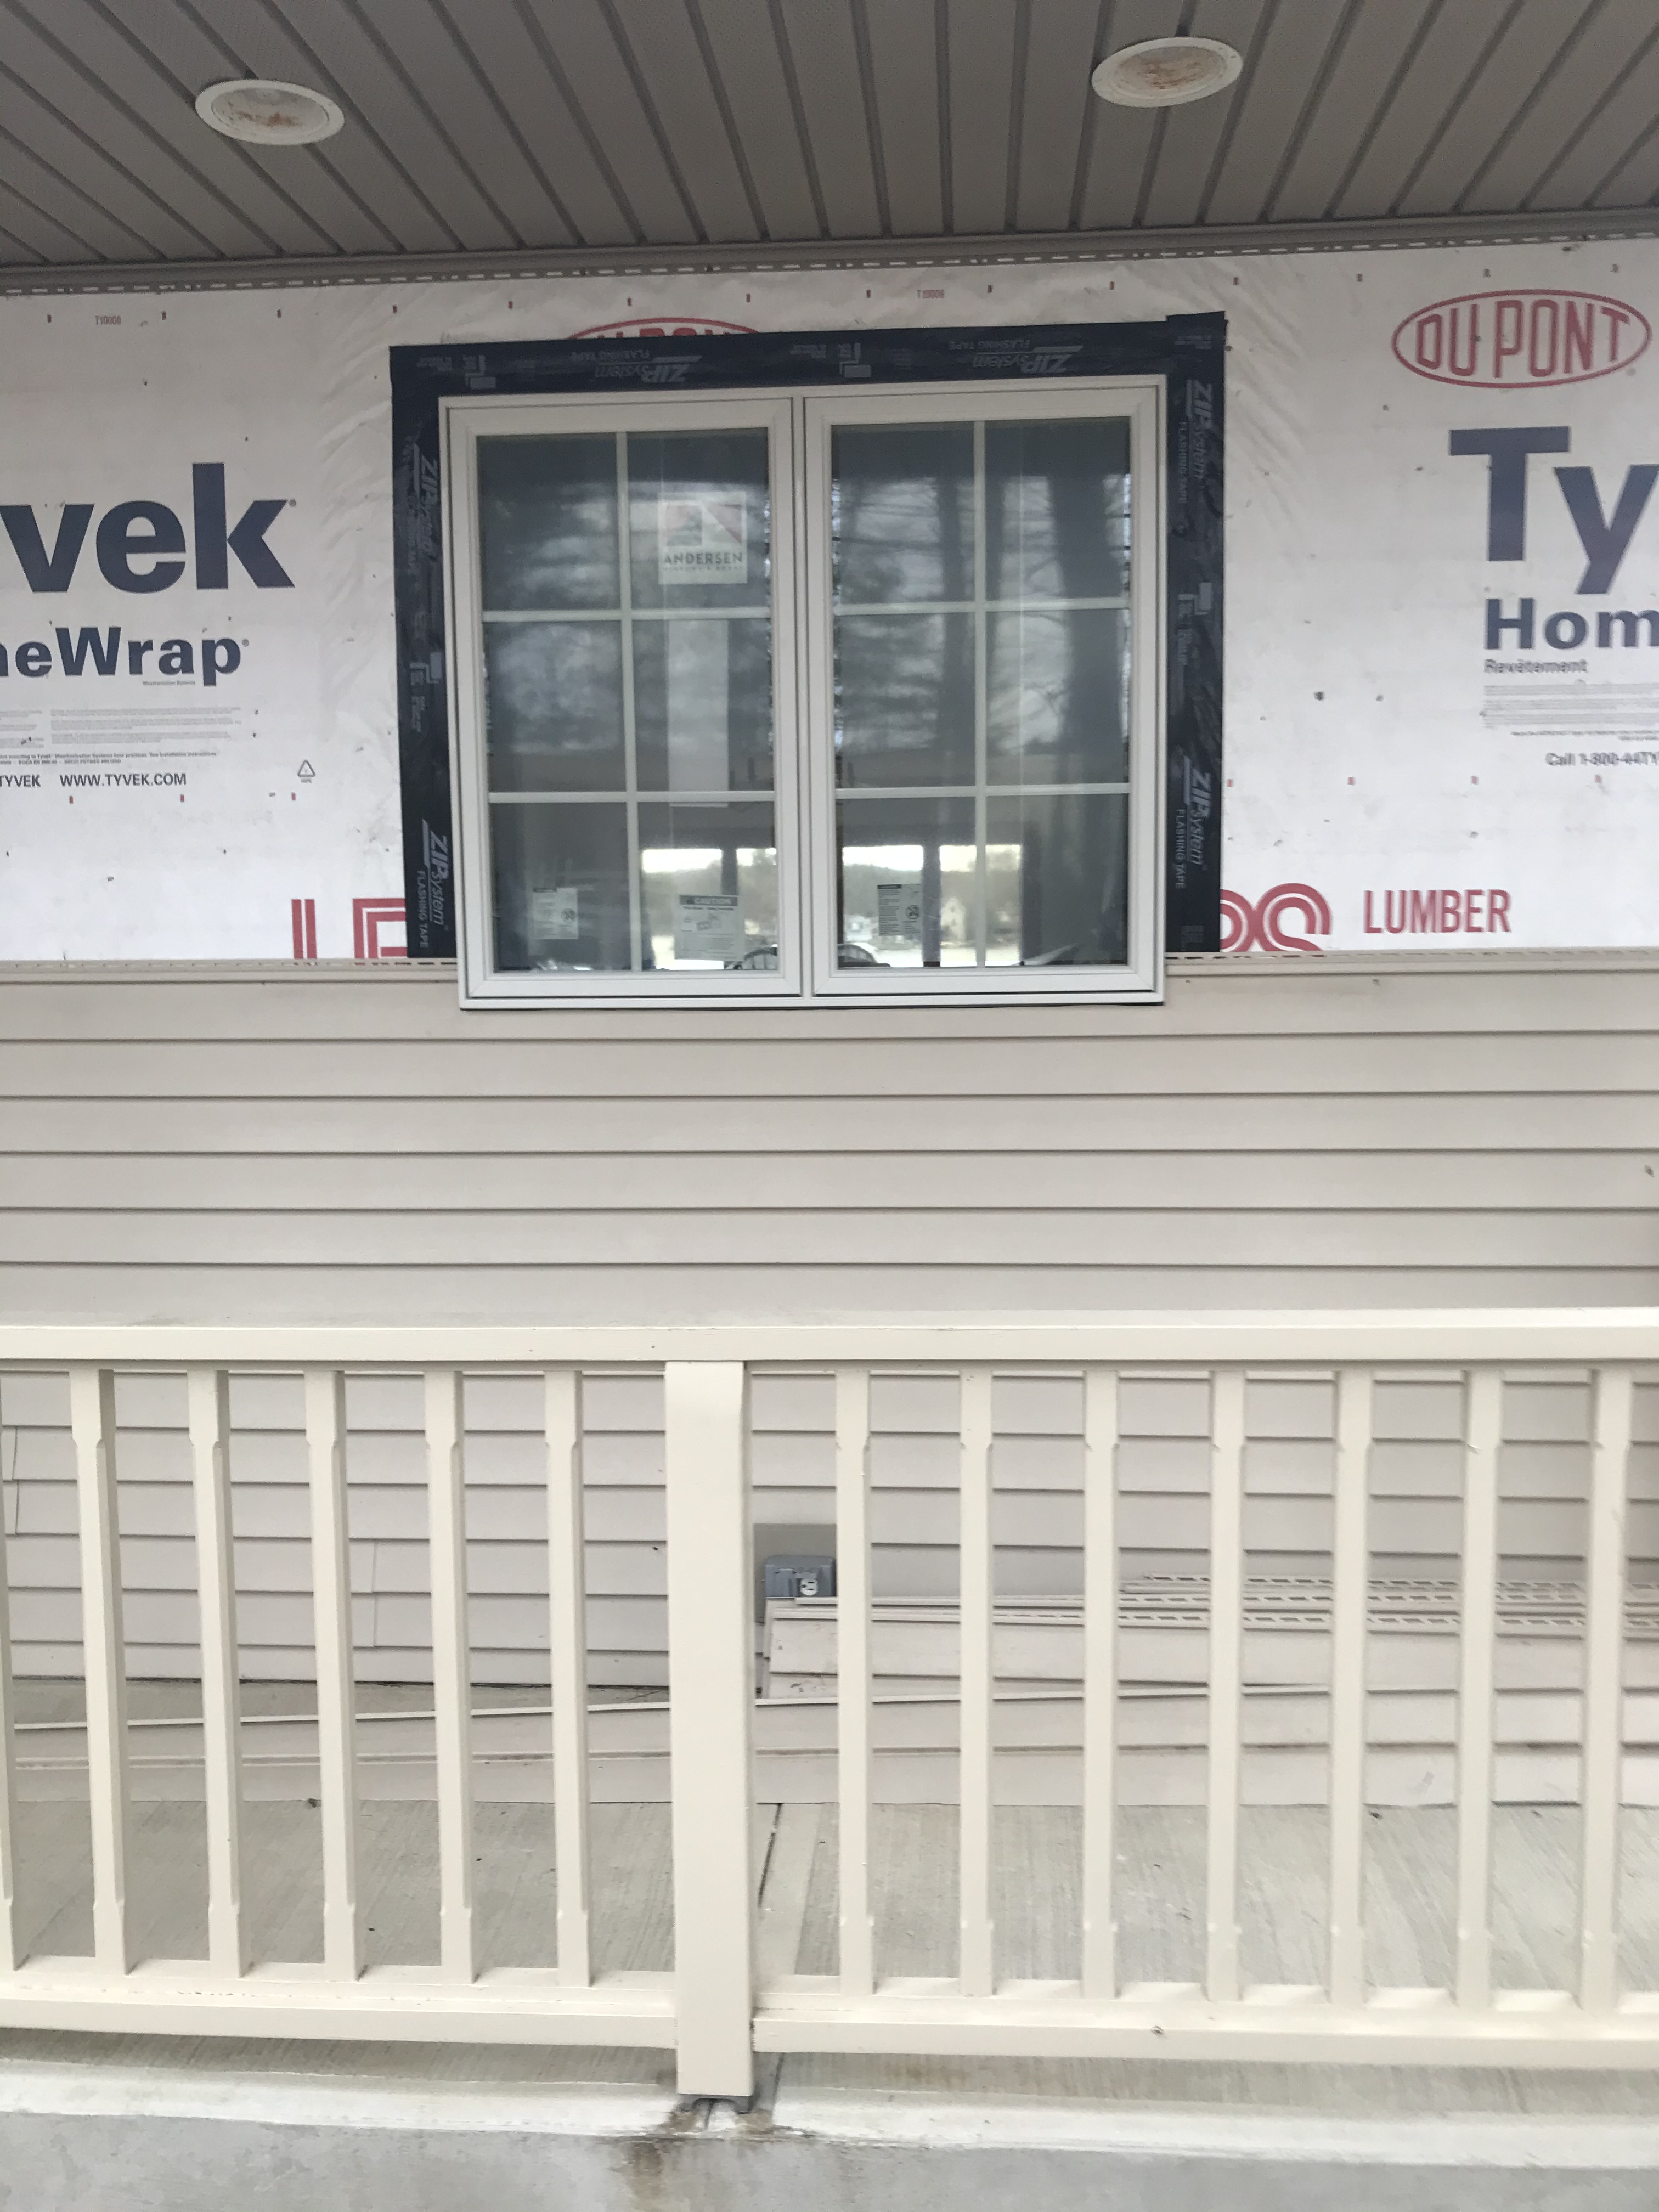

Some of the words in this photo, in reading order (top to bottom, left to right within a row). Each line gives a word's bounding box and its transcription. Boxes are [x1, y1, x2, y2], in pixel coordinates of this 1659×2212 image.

[1448, 426, 1659, 595] Ty
[664, 552, 743, 565] ANDERSEN
[1545, 752, 1576, 766] Call
[59, 773, 187, 788] WWW.TYVEK.COM
[1175, 809, 1186, 860] FLASHING
[1175, 862, 1186, 889] TAPE
[417, 870, 428, 920] FLASHING
[1362, 889, 1513, 934] LUMBER
[419, 923, 430, 948] TAPE
